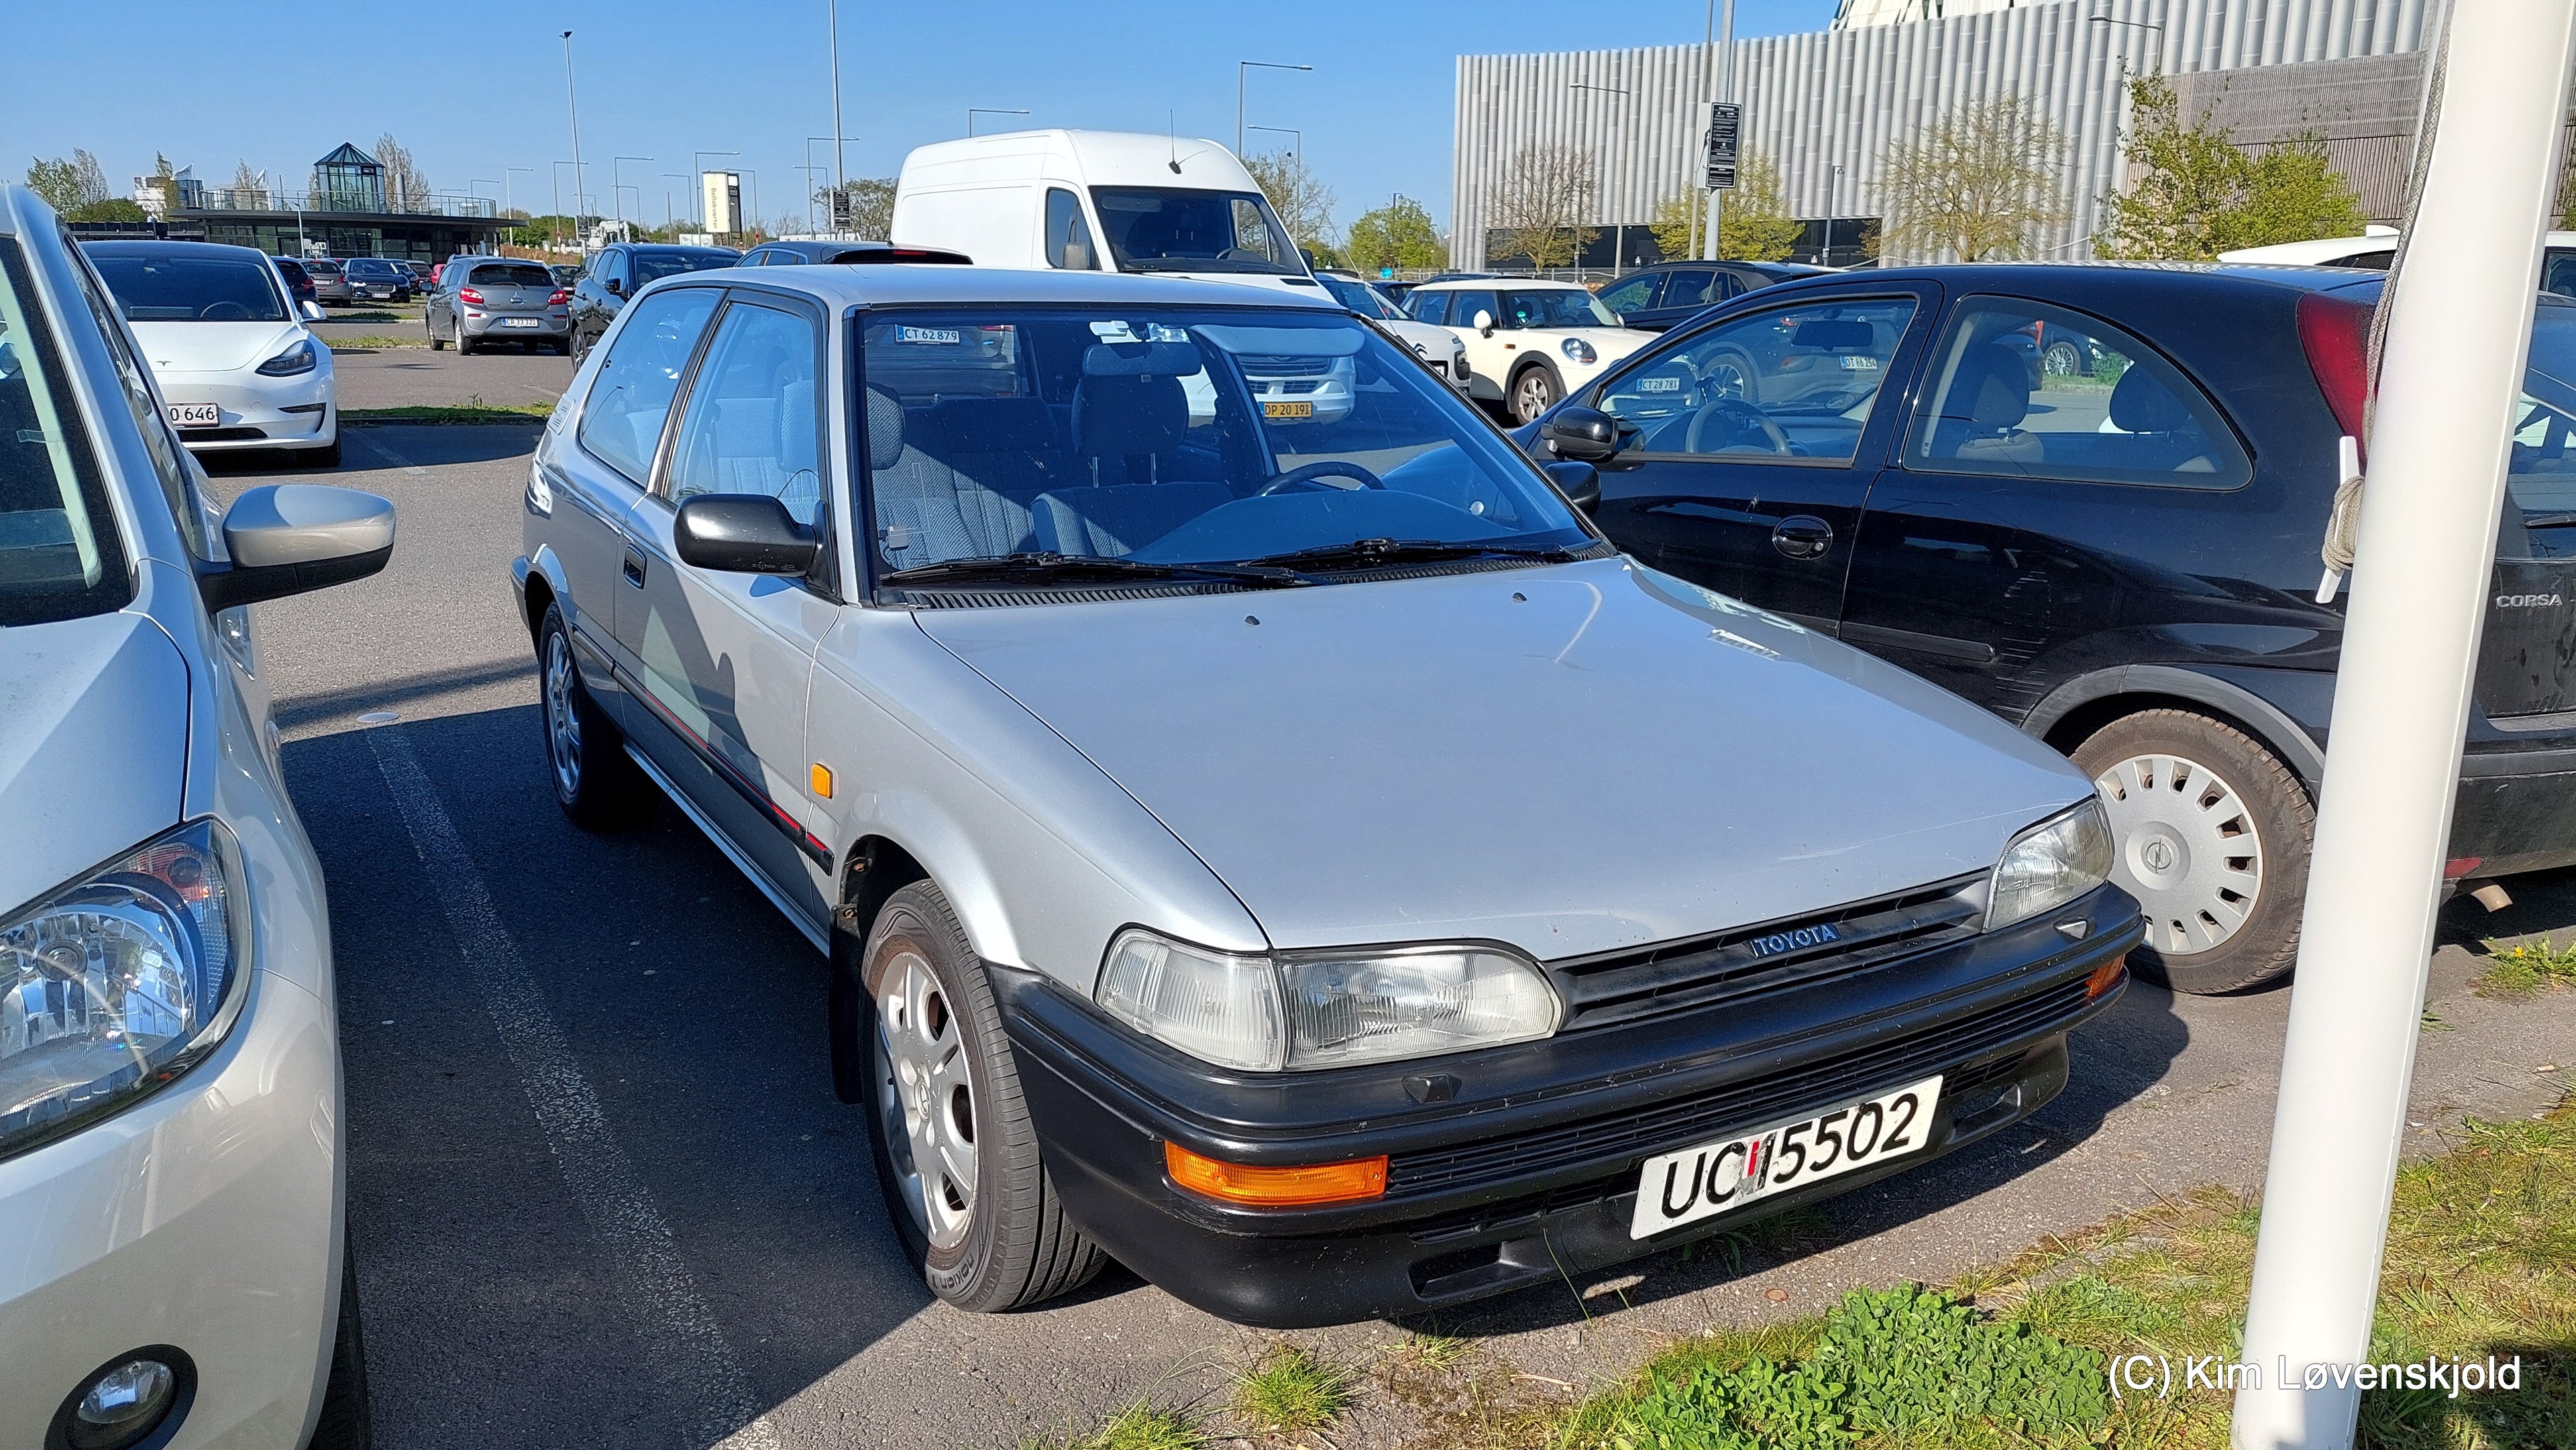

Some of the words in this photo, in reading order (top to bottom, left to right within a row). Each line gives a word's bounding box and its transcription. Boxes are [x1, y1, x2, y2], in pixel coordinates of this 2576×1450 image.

[904, 329, 919, 339] CT
[922, 330, 935, 340] 62
[937, 331, 957, 341] 879
[1642, 380, 1653, 389] CT
[1654, 380, 1663, 389] 28
[1664, 380, 1677, 389] 781
[170, 408, 180, 421] 0
[184, 407, 215, 421] 646
[1265, 404, 1277, 415] DP
[1280, 404, 1291, 415] 20
[1294, 404, 1309, 415] 191
[2496, 594, 2563, 608] CORSA
[1754, 924, 1837, 955] TOYOTA
